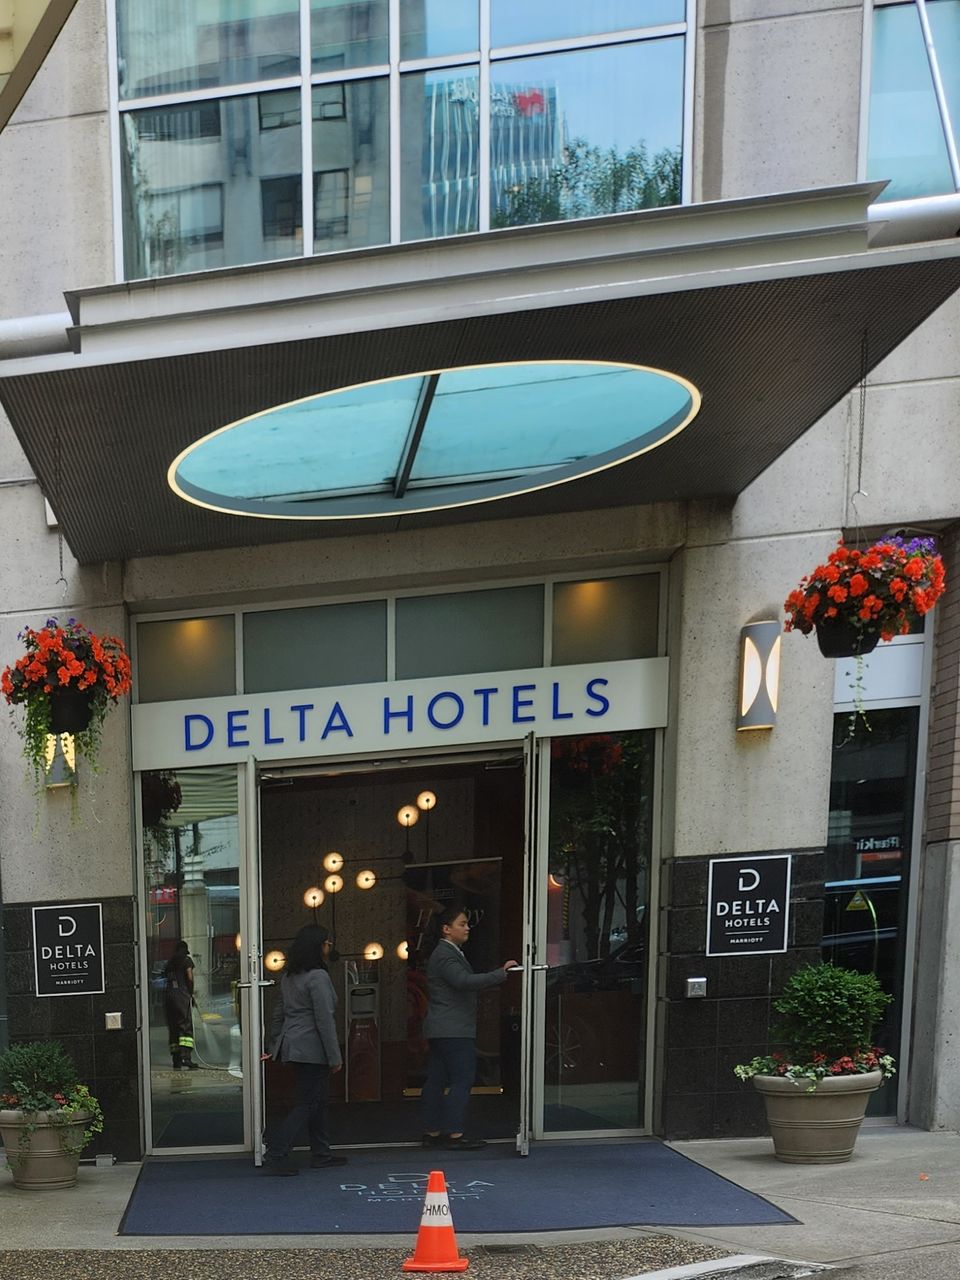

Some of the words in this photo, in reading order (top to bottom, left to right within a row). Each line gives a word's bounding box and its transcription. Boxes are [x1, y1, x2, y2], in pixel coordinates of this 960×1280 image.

[184, 701, 354, 751] DELTA
[383, 678, 610, 735] HOTELS
[739, 868, 760, 891] D
[716, 899, 780, 916] DELTA
[58, 916, 76, 936] D
[725, 917, 770, 928] HOTELS
[41, 944, 96, 960] DELTA
[50, 961, 88, 970] HOTELS
